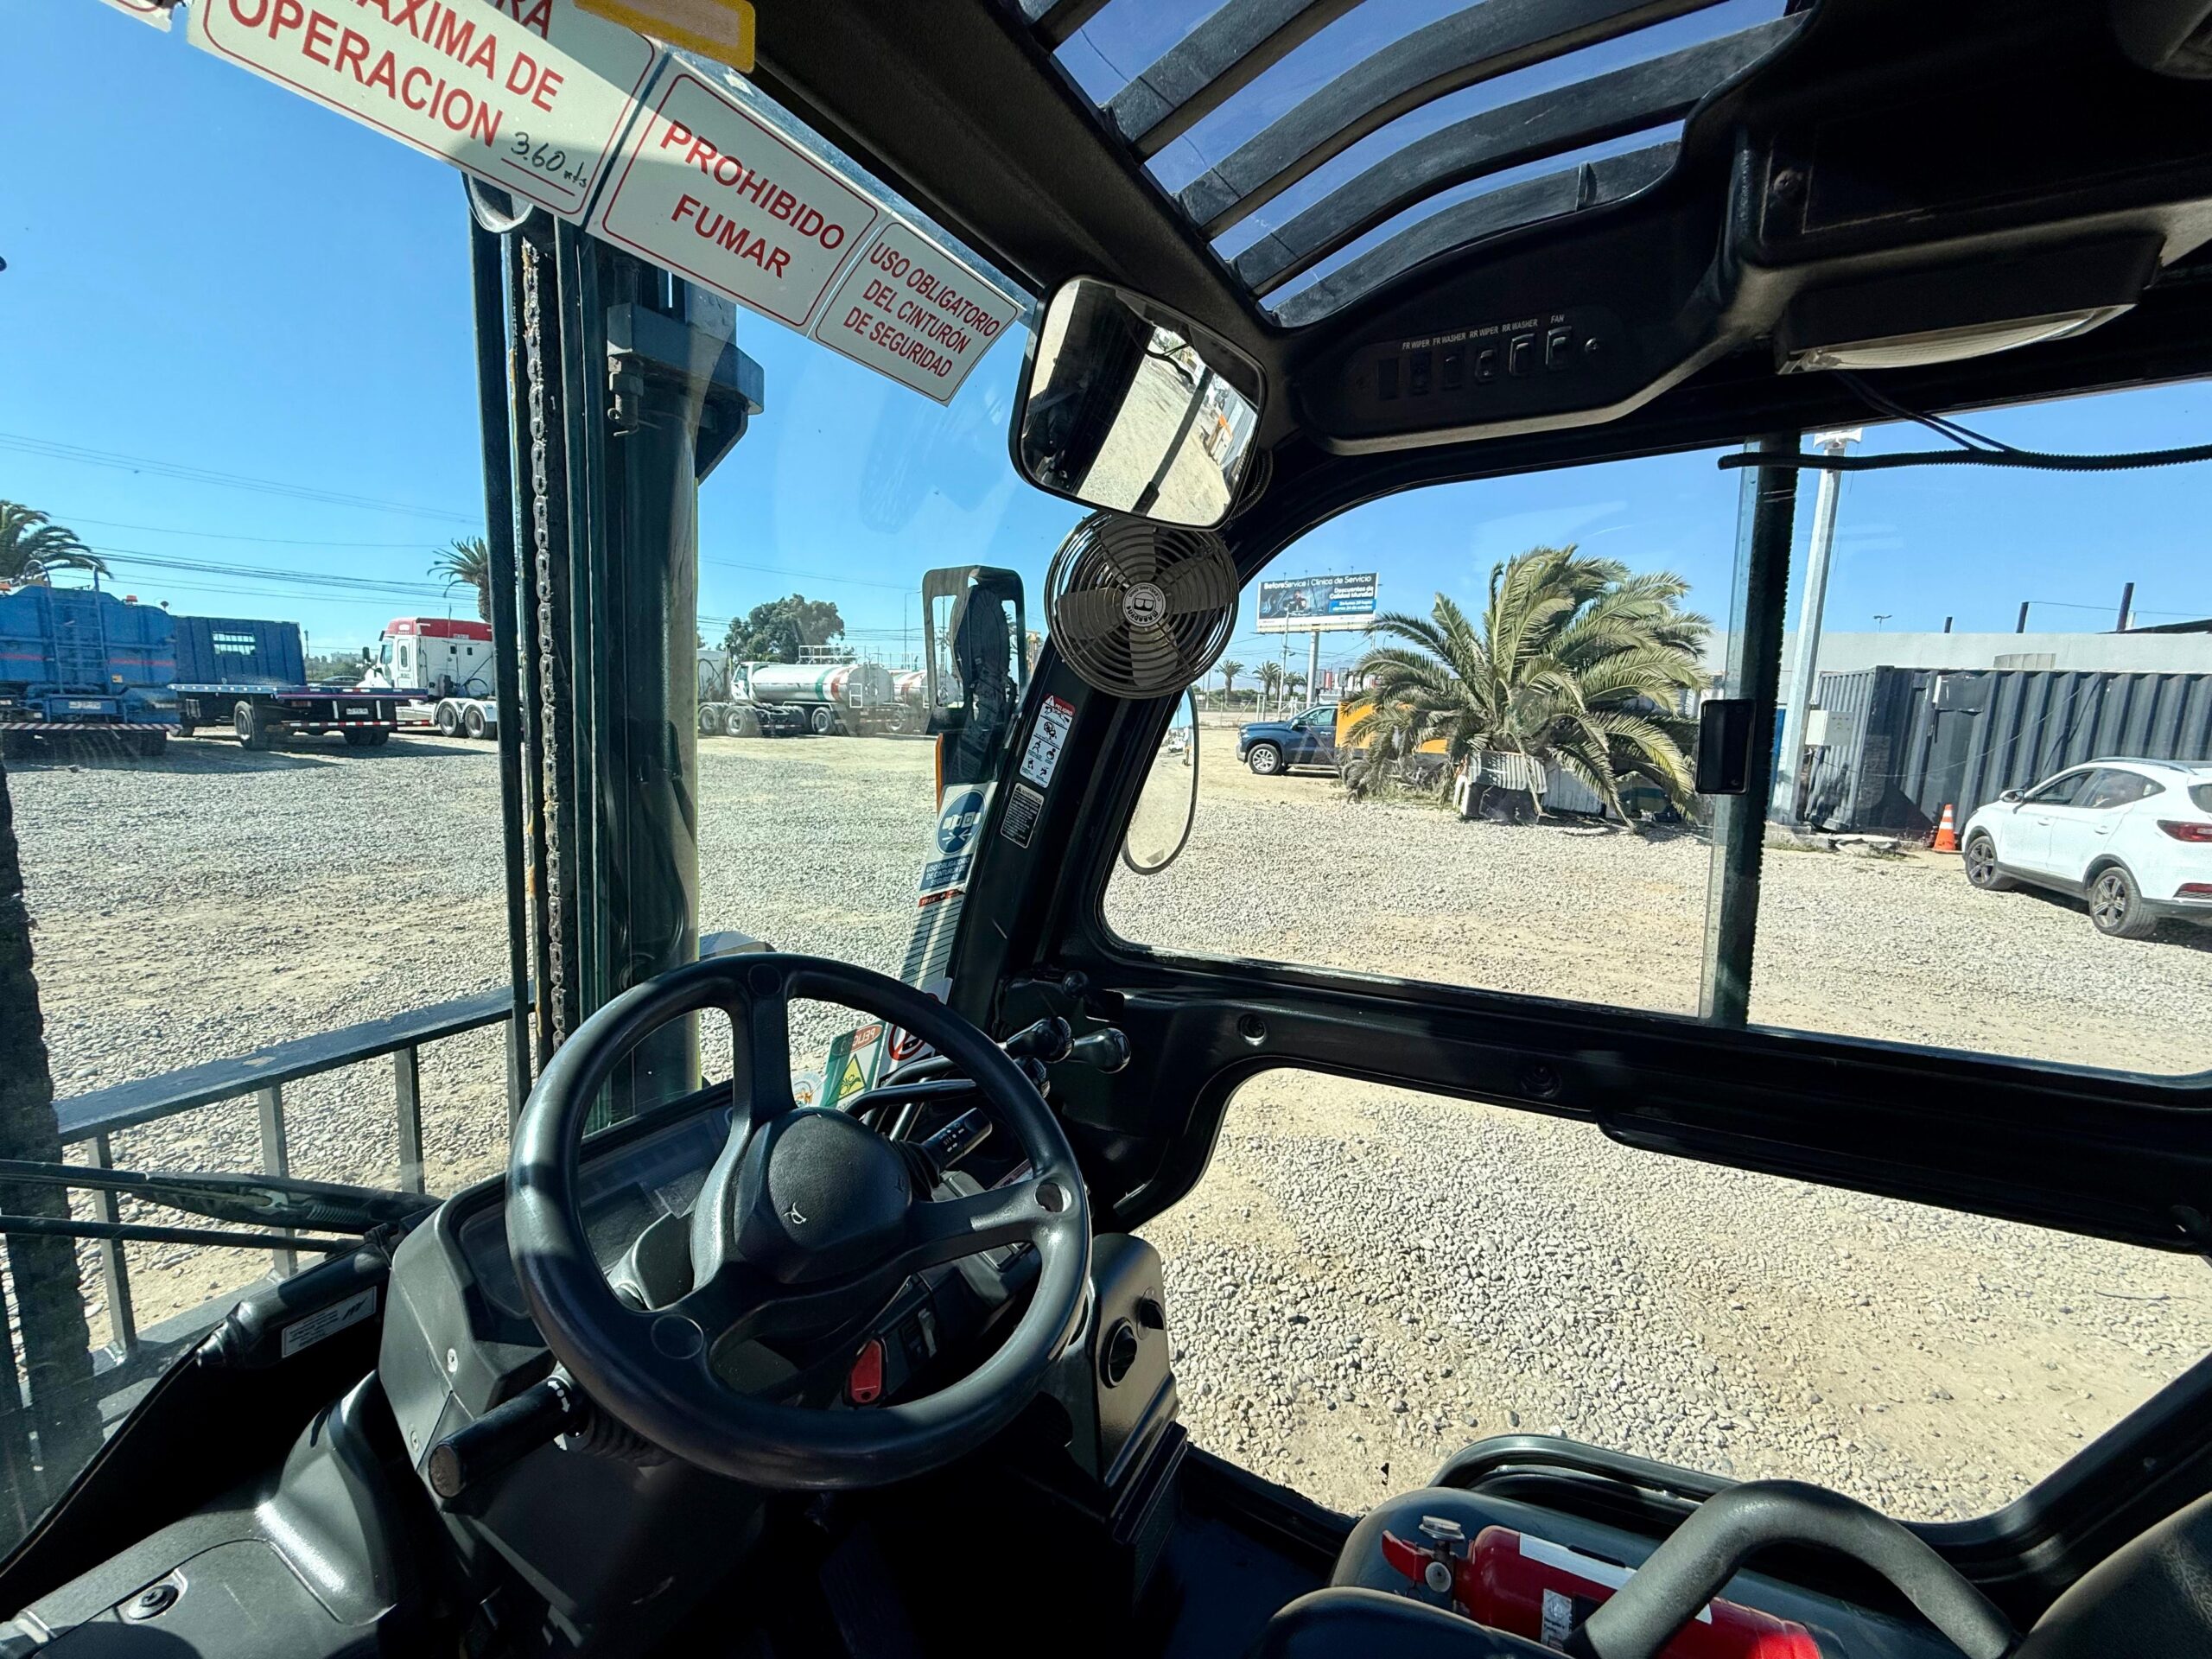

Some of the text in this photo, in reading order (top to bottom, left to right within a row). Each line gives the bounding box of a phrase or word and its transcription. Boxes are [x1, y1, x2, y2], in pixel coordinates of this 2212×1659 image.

[228, 0, 503, 147] OPERACION
[505, 51, 564, 112] DE
[660, 119, 844, 250] PROHIBIDO
[671, 194, 791, 278] FUMAR
[862, 278, 971, 354] DEL CINTURÓN
[870, 242, 1000, 337] USO OBLIGATORIO
[1550, 315, 1565, 323] FAN
[843, 306, 953, 378] DE SEGURIDAD
[1402, 340, 1430, 351] FR WIPER
[1441, 332, 1466, 343] WASHER
[1469, 326, 1498, 339] RR WIPER
[1502, 318, 1538, 332] RR WASHER
[1344, 575, 1372, 584] Servicio
